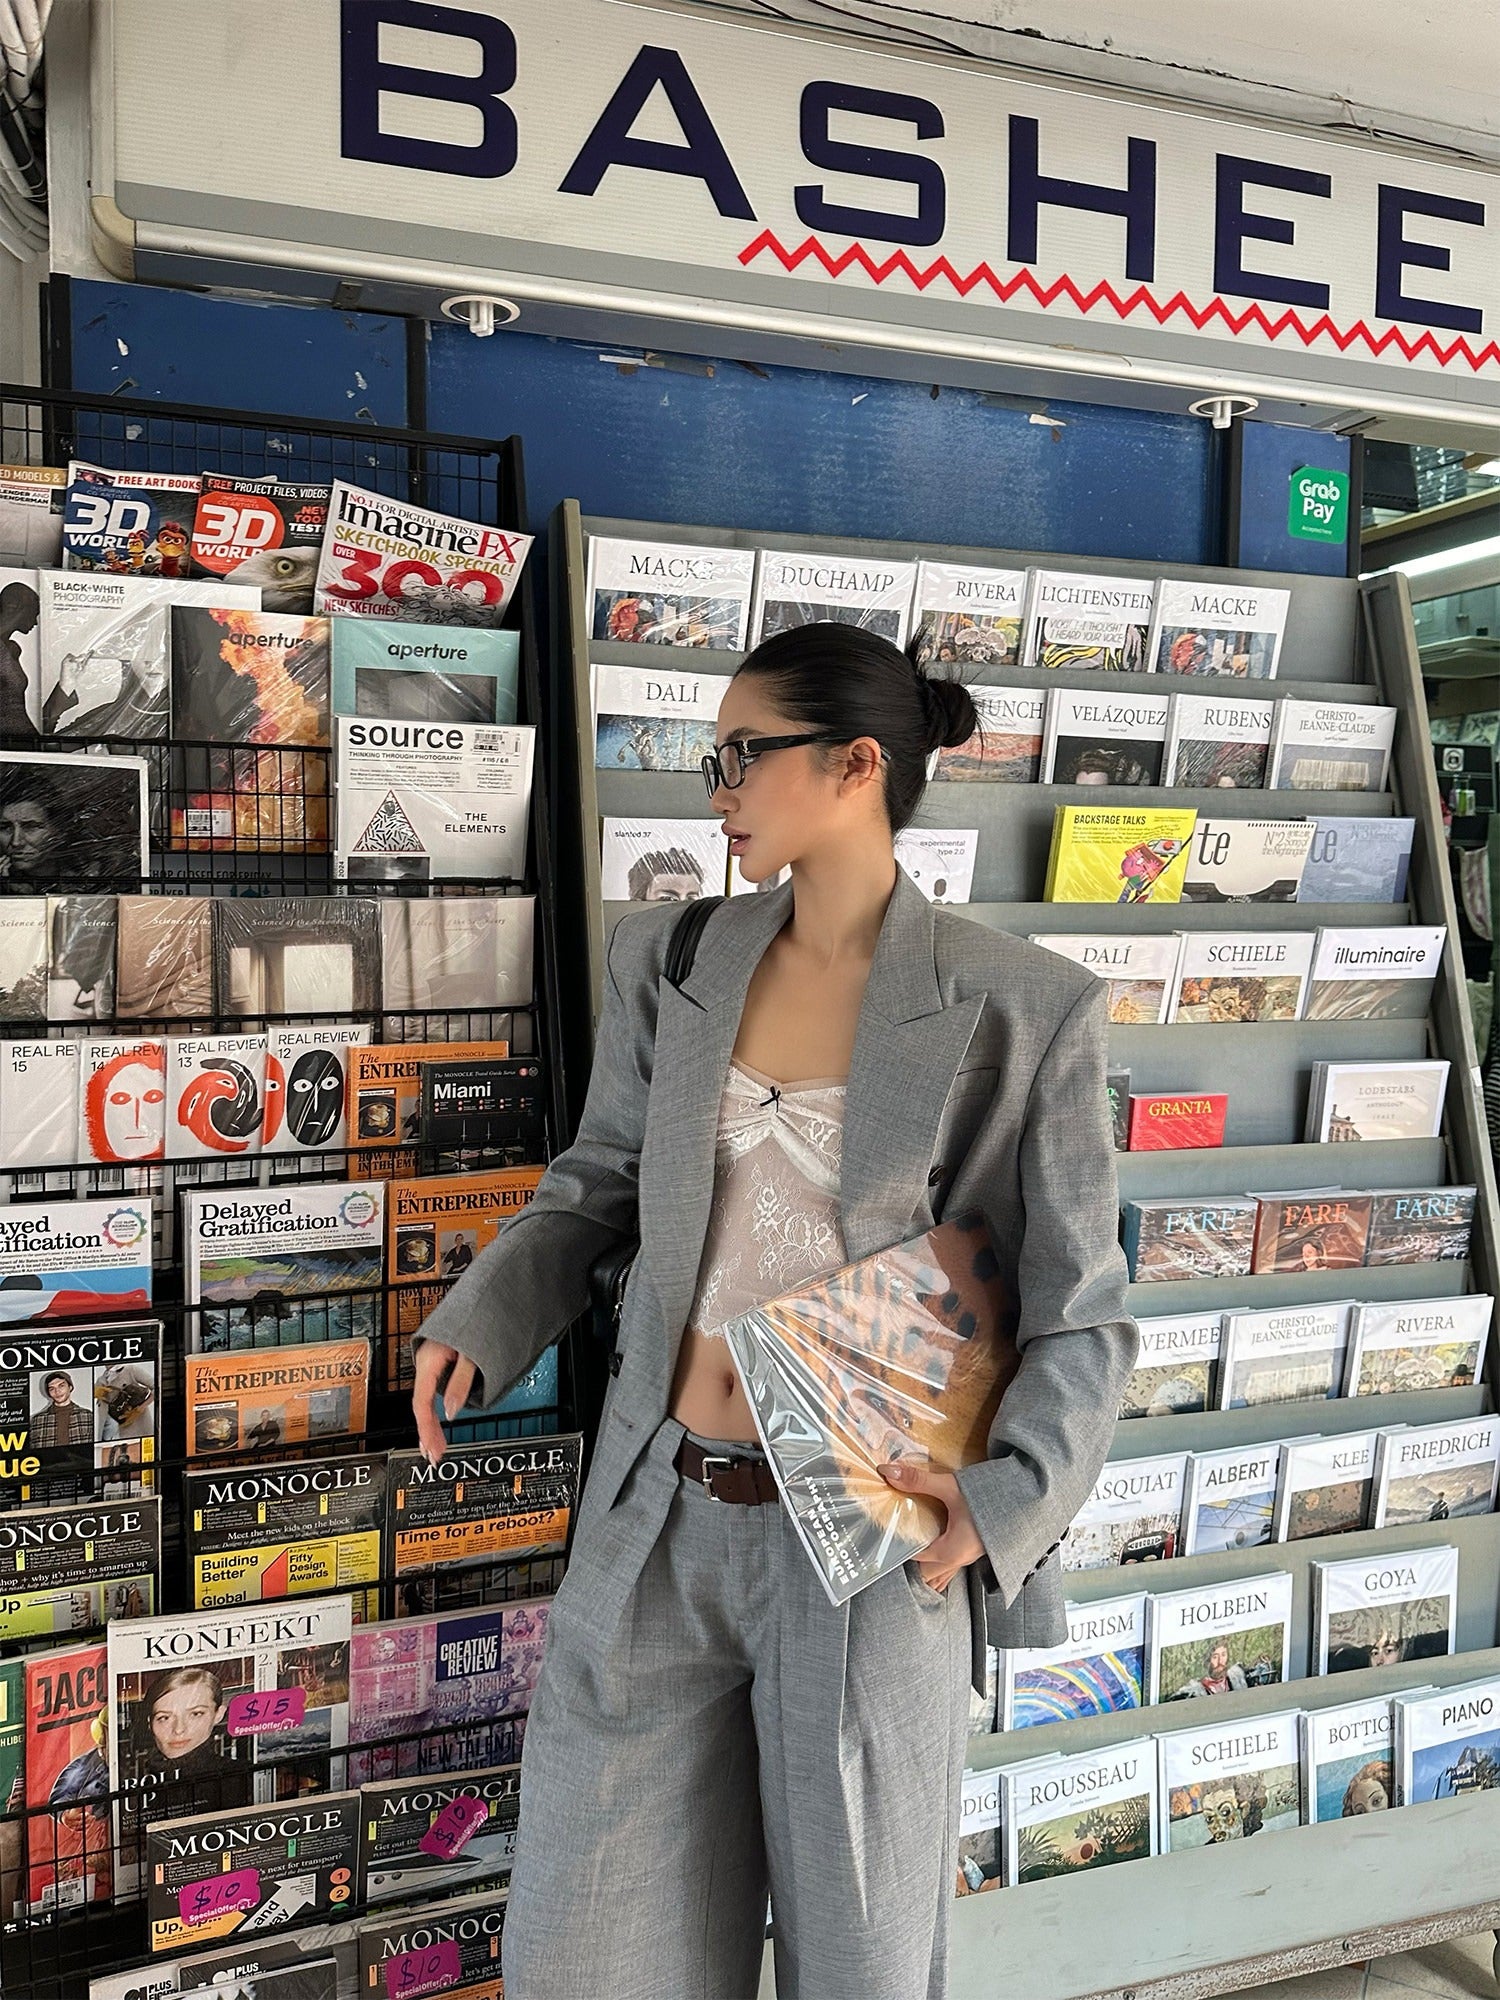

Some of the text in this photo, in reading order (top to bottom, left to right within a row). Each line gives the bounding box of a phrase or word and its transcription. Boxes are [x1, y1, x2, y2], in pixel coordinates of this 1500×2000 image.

[14, 471, 51, 482] MODELS
[118, 476, 201, 490] FREE ART BOOKS
[234, 482, 272, 495] PROJECT
[273, 486, 298, 498] FILES,
[300, 489, 328, 499] VIDEOS
[1299, 478, 1340, 502] Grab
[63, 493, 150, 537] 3D
[350, 492, 480, 536] NO.1 FOR DIGITAL ARTISTS
[1302, 498, 1336, 524] Pay
[192, 504, 277, 548] 3D
[338, 490, 524, 563] ImagineFX
[333, 524, 515, 577] SKETCHBOOK SPECIAL!
[335, 546, 357, 559] OVER
[780, 566, 895, 594] DUCHAMP
[53, 592, 124, 604] PHOTOGRAPHY
[955, 580, 1017, 602] RIVERA
[324, 598, 400, 617] NEW SKETCHES!
[1190, 595, 1258, 618] MACKE
[228, 631, 314, 650] aperture
[388, 642, 468, 660] aperture
[646, 682, 700, 704] DALÍ
[1072, 704, 1166, 726] VELÁZQUEZ
[1204, 708, 1272, 729] RUBENS
[1315, 710, 1356, 722] CHRISTO
[349, 724, 464, 750] source
[1300, 720, 1376, 735] JEANNE-CLAUDE
[349, 751, 463, 762] THINKING THROUGH PHOTOGRAPHY
[464, 812, 488, 822] THE
[1074, 814, 1120, 824] BACKSTAGE
[1122, 816, 1146, 825] TALKS
[444, 824, 506, 834] ELEMENTS
[1198, 823, 1231, 866] te
[1082, 945, 1132, 965] DALÍ
[1208, 944, 1287, 964] SCHIELE
[1334, 946, 1426, 964] illuminaire
[178, 1038, 268, 1054] REAL REVIEW
[278, 1031, 360, 1045] REAL REVIEW
[12, 1046, 52, 1058] REAL
[91, 1046, 130, 1058] REAL
[178, 1056, 192, 1068] 13
[278, 1048, 290, 1059] 12
[359, 1054, 380, 1064] The
[12, 1062, 27, 1072] 15
[91, 1062, 105, 1072] 14
[434, 1082, 492, 1100] Miami
[1359, 1085, 1415, 1096] LODESTARS
[1148, 1100, 1212, 1117] GRANTA
[396, 1188, 417, 1199] The
[200, 1198, 293, 1222] Delayed
[1284, 1202, 1350, 1227] FARE
[1394, 1195, 1458, 1220] FARE
[200, 1214, 338, 1238] Gratification
[1165, 1209, 1238, 1235] FARE
[1268, 1314, 1315, 1330] CHRISTO
[1394, 1315, 1456, 1334] RIVERA
[1252, 1323, 1338, 1345] JEANNE-CLAUDE
[0, 1338, 142, 1370] ONOCLE
[196, 1366, 218, 1377] The
[196, 1360, 362, 1394] ENTREPRENEURS
[1400, 1430, 1492, 1462] FRIEDRICH
[408, 1449, 564, 1486] MONOCLE
[1332, 1448, 1370, 1469] KLEE
[1204, 1460, 1270, 1488] ALBERT
[206, 1466, 372, 1505] MONOCLE
[456, 1508, 470, 1516] top
[471, 1506, 485, 1514] tips
[486, 1502, 497, 1510] for
[498, 1500, 510, 1509] the
[228, 1532, 248, 1540] Meet
[250, 1529, 264, 1538] the
[283, 1524, 300, 1534] kids
[314, 1520, 328, 1528] the
[329, 1516, 350, 1526] block
[398, 1530, 440, 1546] Time
[444, 1525, 468, 1538] for
[474, 1524, 484, 1536] a
[488, 1510, 555, 1532] reboot?
[805, 1476, 860, 1580] PHOTOGRAPHY
[808, 1507, 850, 1586] EUROPEAN
[202, 1554, 258, 1571] Building
[289, 1554, 314, 1564] Fifty
[289, 1562, 326, 1574] Design
[31, 1573, 50, 1583] why
[51, 1571, 65, 1580] it's
[66, 1568, 86, 1578] time
[99, 1563, 134, 1573] smarten
[136, 1560, 148, 1568] up
[202, 1568, 246, 1583] Better
[289, 1569, 328, 1582] Awards
[1364, 1567, 1418, 1592] GOYA
[202, 1590, 246, 1608] Global
[1180, 1592, 1268, 1626] HOLBEIN
[144, 1614, 320, 1660] KONFEKT
[1070, 1612, 1134, 1643] URISM
[440, 1634, 498, 1662] CREATIVE
[258, 1654, 272, 1666] 2.
[448, 1652, 498, 1677] REVIEW
[121, 1677, 132, 1690] 1.
[240, 1698, 290, 1722] $15
[1442, 1698, 1494, 1726] PIANO
[1190, 1731, 1279, 1766] SCHIELE
[1030, 1760, 1138, 1807] ROUSSEAU
[168, 1809, 342, 1860] MONOCLE
[432, 1804, 466, 1848] $10
[374, 1842, 390, 1851] Get
[267, 1852, 343, 1874] next for transport?
[192, 1882, 240, 1911] $10
[155, 1922, 183, 1935] Up,
[235, 1962, 259, 1976] PLUS
[398, 1956, 440, 1988] $10
[150, 1980, 172, 1994] PLUS
